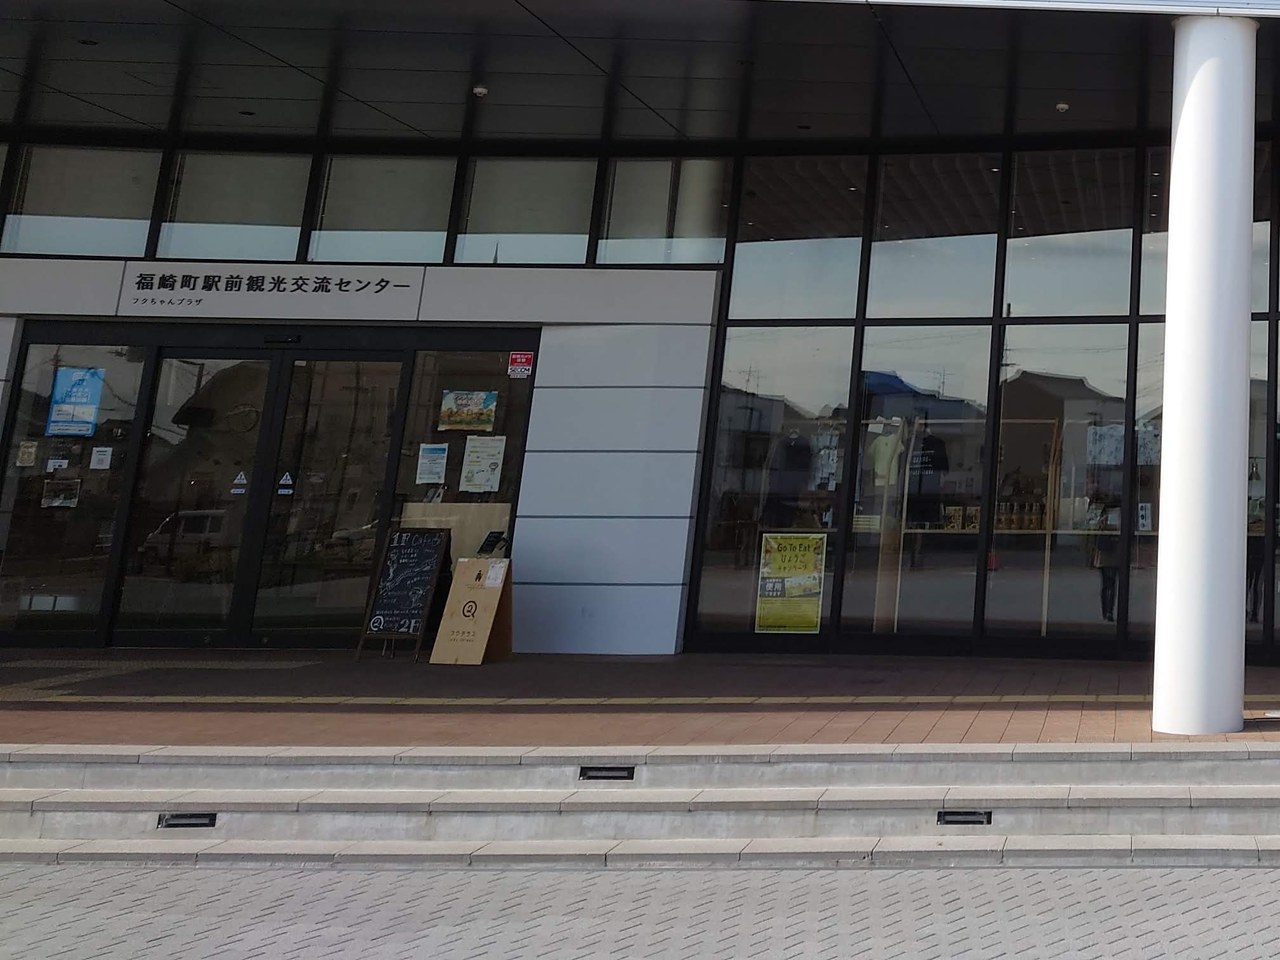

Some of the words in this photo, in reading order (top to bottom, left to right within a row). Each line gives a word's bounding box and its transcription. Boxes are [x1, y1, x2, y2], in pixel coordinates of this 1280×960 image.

[135, 273, 411, 294] 福崎町駅前観光交流センター
[132, 297, 204, 306] フクちゃんプラザ
[777, 543, 787, 552] Go
[789, 543, 797, 552] To
[798, 543, 811, 552] Eat
